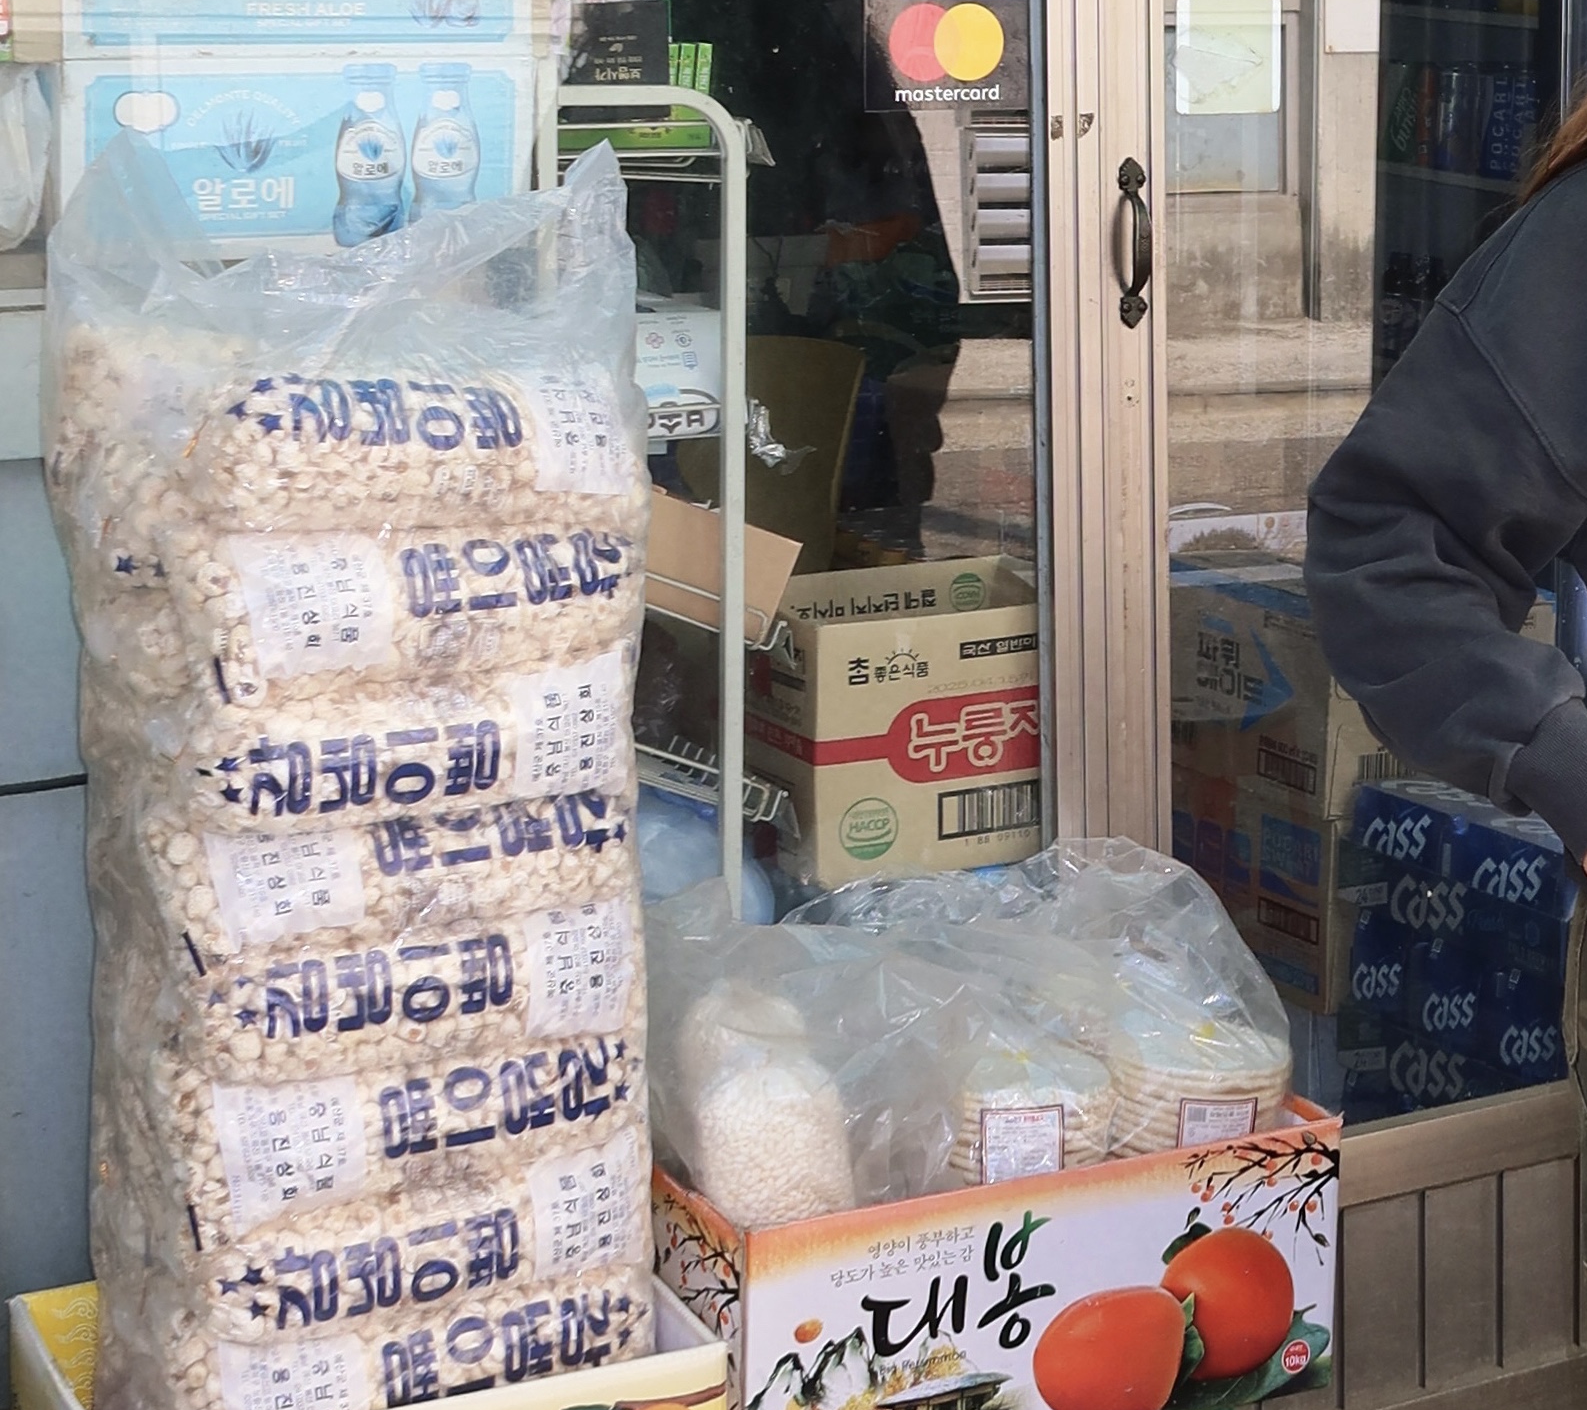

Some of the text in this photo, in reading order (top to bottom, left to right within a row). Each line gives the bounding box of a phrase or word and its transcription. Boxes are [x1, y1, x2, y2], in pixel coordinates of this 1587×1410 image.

[246, 1, 367, 17] FRESH ALOE
[894, 84, 1000, 103] mastercard
[192, 175, 295, 211] 알로에
[904, 587, 936, 610] 절대
[962, 642, 992, 656] 국산
[849, 818, 891, 833] HACCP
[867, 1226, 976, 1260] 영양이 풍부하고
[830, 1244, 975, 1287] 당도가 높은 맛있는 감
[861, 1209, 1057, 1358] 대봉
